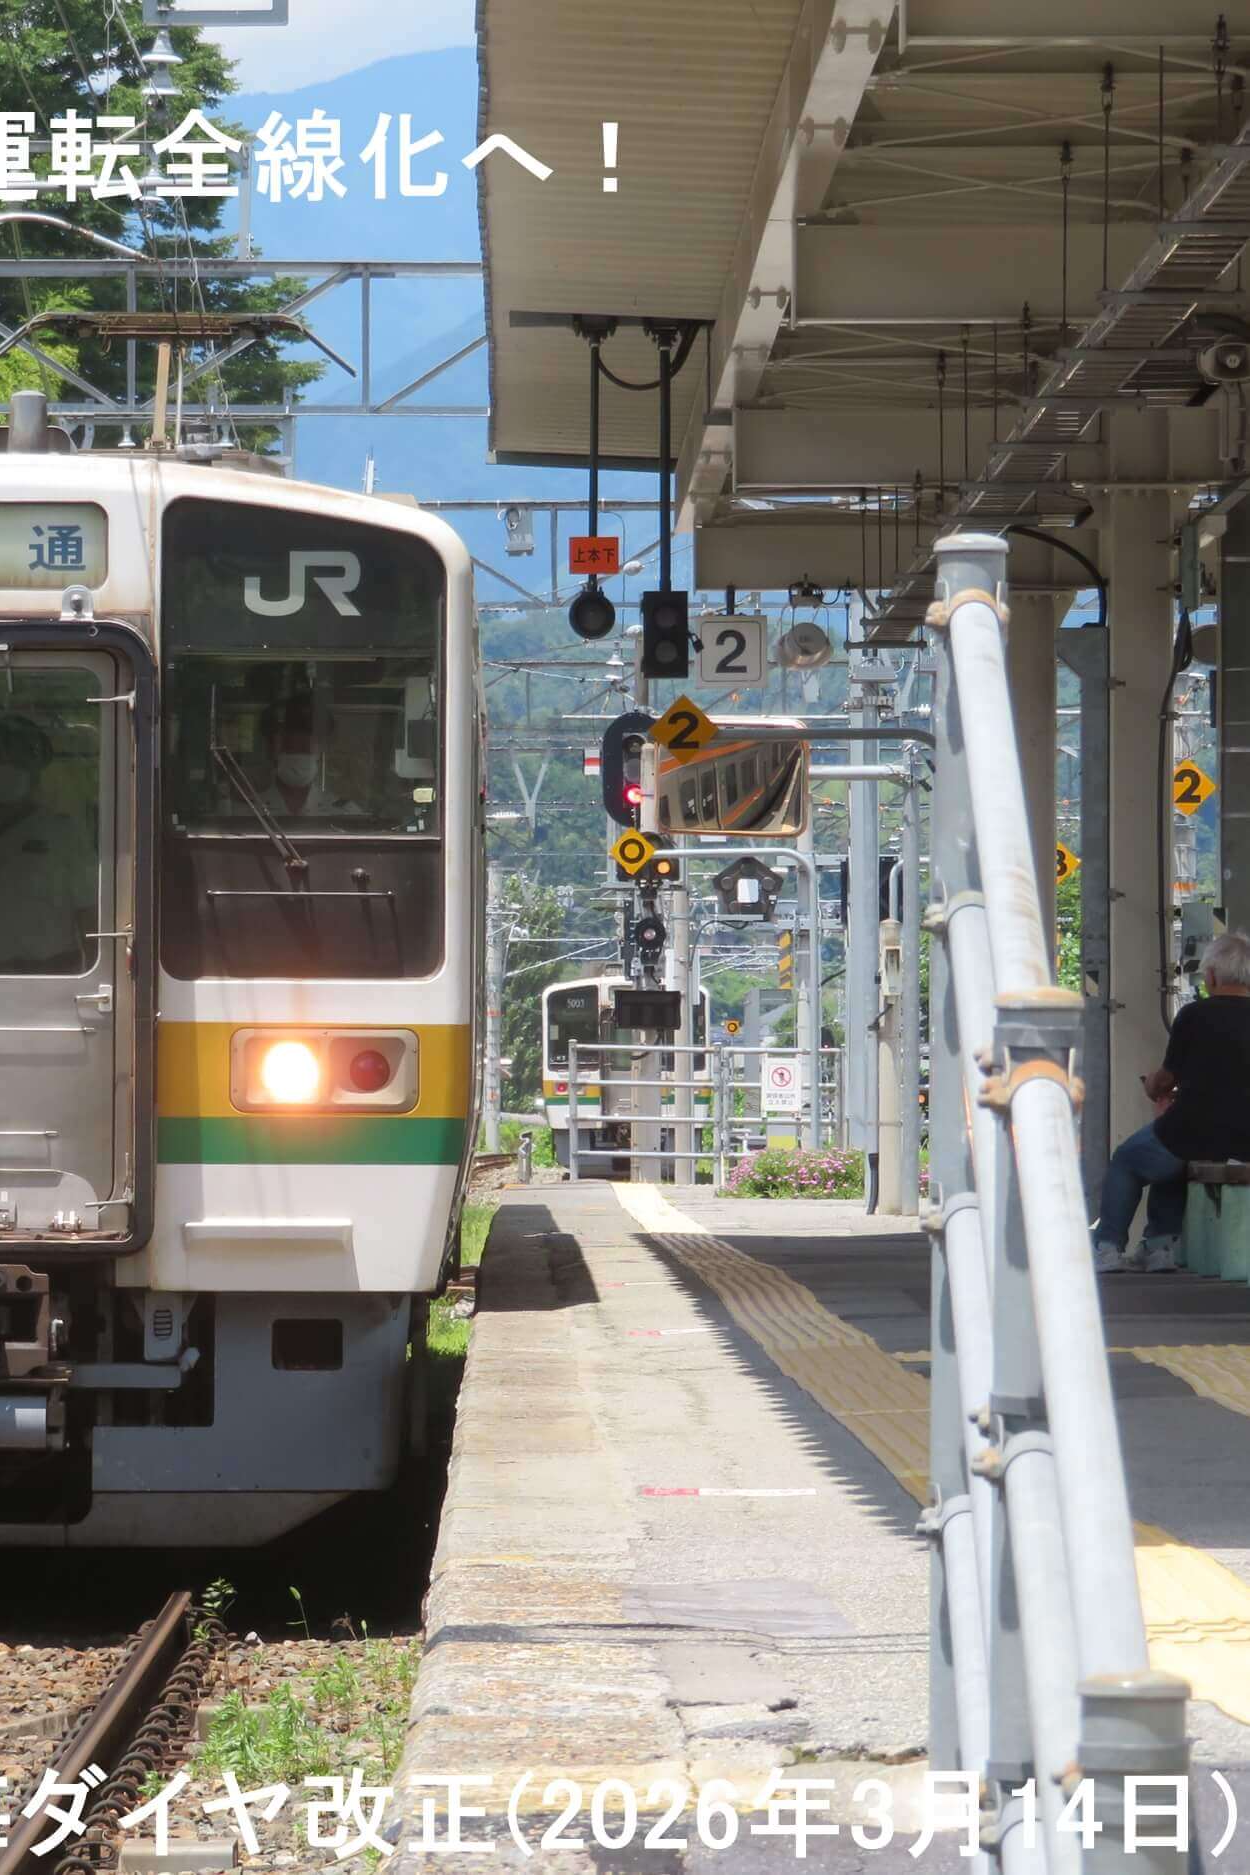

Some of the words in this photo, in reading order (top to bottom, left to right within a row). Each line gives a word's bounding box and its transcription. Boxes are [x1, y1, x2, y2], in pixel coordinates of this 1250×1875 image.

[574, 545, 615, 564] 上本下
[244, 550, 362, 617] JR
[715, 629, 747, 673] 2
[668, 711, 699, 748] 2
[1174, 768, 1201, 803] 2
